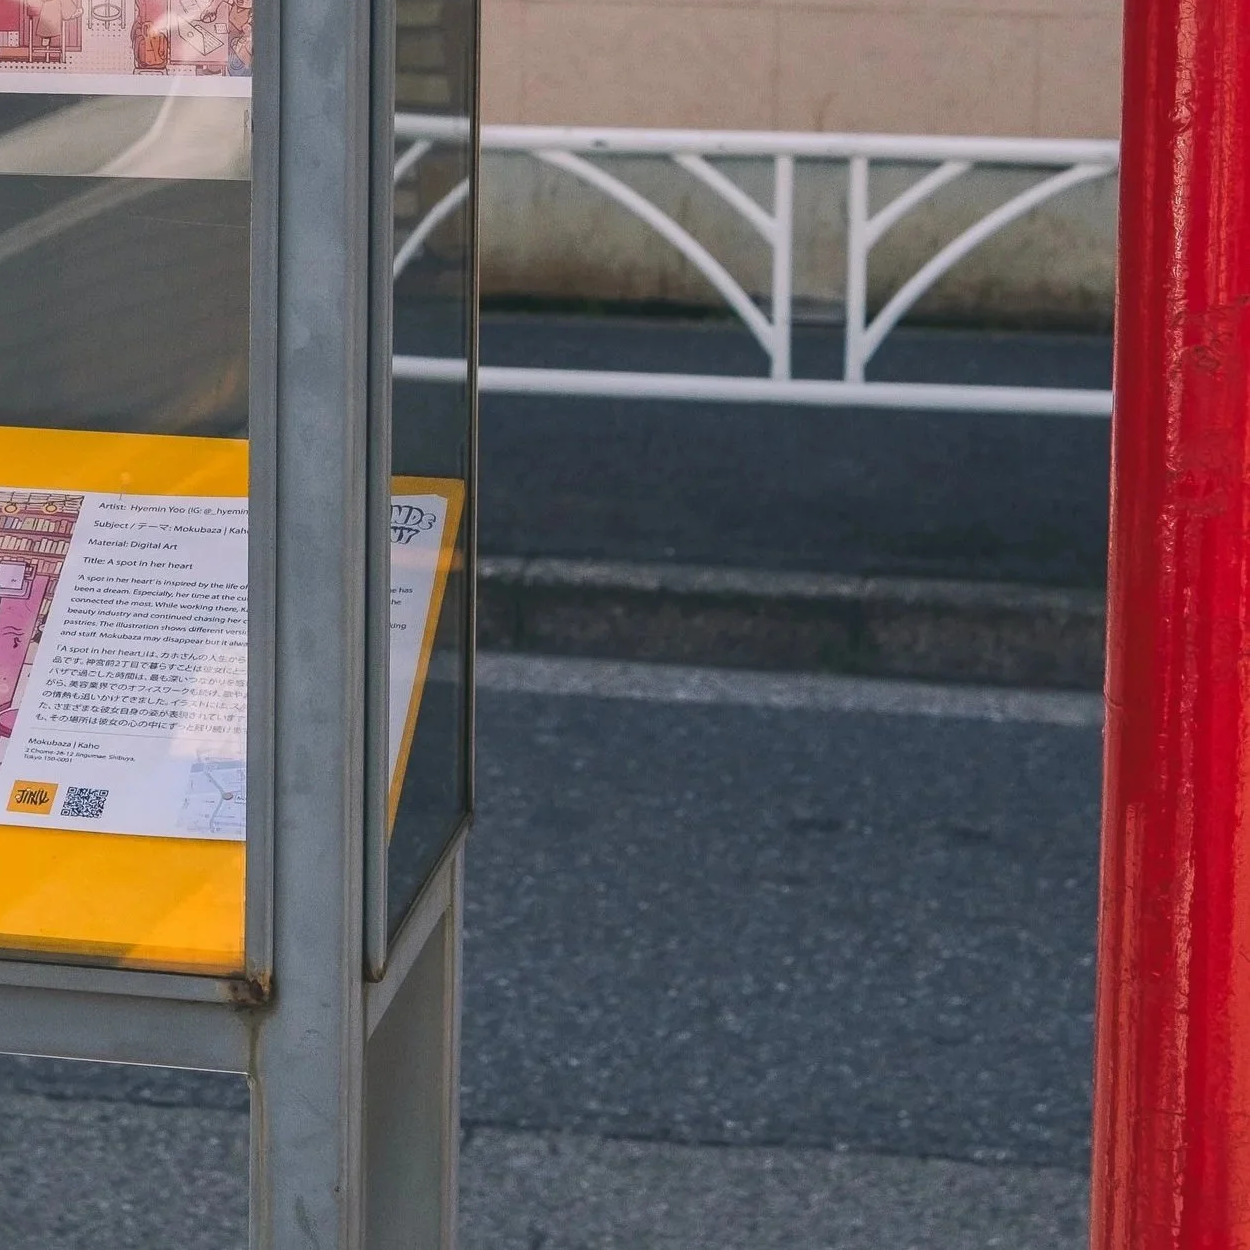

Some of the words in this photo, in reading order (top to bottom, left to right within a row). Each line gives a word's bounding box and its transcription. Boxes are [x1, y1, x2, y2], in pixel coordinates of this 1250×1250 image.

[98, 502, 127, 511] Artist:
[130, 504, 166, 513] Hyemin
[168, 506, 186, 514] Yoo
[94, 520, 129, 529] Subject
[173, 525, 222, 534] Mokubaza
[88, 538, 129, 548] Material:
[130, 541, 161, 550] Digital
[83, 556, 106, 565] Title:
[168, 562, 193, 570] heart
[74, 585, 95, 593] been
[70, 597, 114, 605] connected
[155, 601, 178, 609] While
[179, 603, 214, 611] working
[67, 607, 96, 616] beauty
[97, 609, 131, 619] industry
[150, 613, 192, 621] continued
[193, 615, 226, 624] chasing
[115, 621, 159, 630] illustration
[161, 624, 187, 632] shows
[188, 626, 224, 634] different
[99, 632, 141, 640] Mokubaza
[162, 636, 203, 644] disappear
[70, 646, 89, 654] spot
[28, 738, 71, 747] Mokubaza
[78, 742, 100, 750] Kaho
